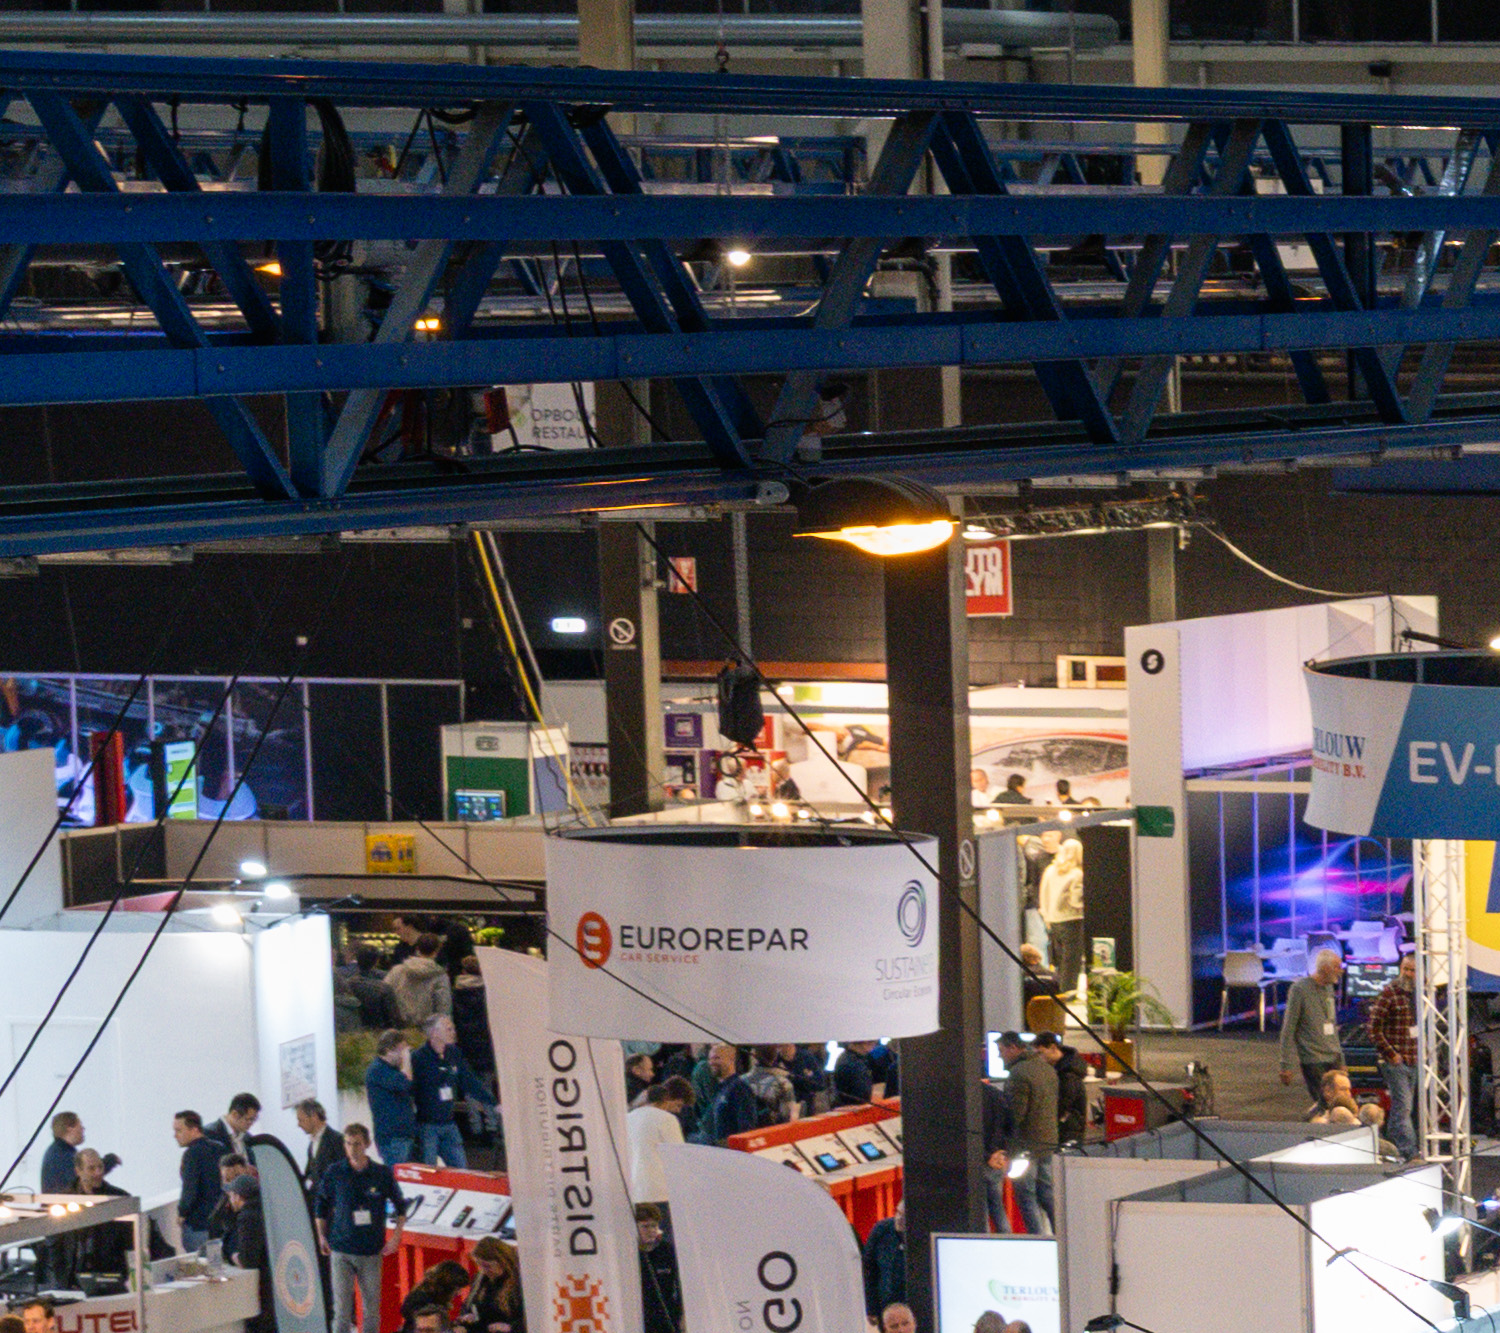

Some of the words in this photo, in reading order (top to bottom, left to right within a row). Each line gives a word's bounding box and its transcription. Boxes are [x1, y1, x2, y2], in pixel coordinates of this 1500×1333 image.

[620, 925, 809, 951] EUROREPAR
[620, 954, 643, 962] CAR
[647, 954, 699, 964] SERVICE
